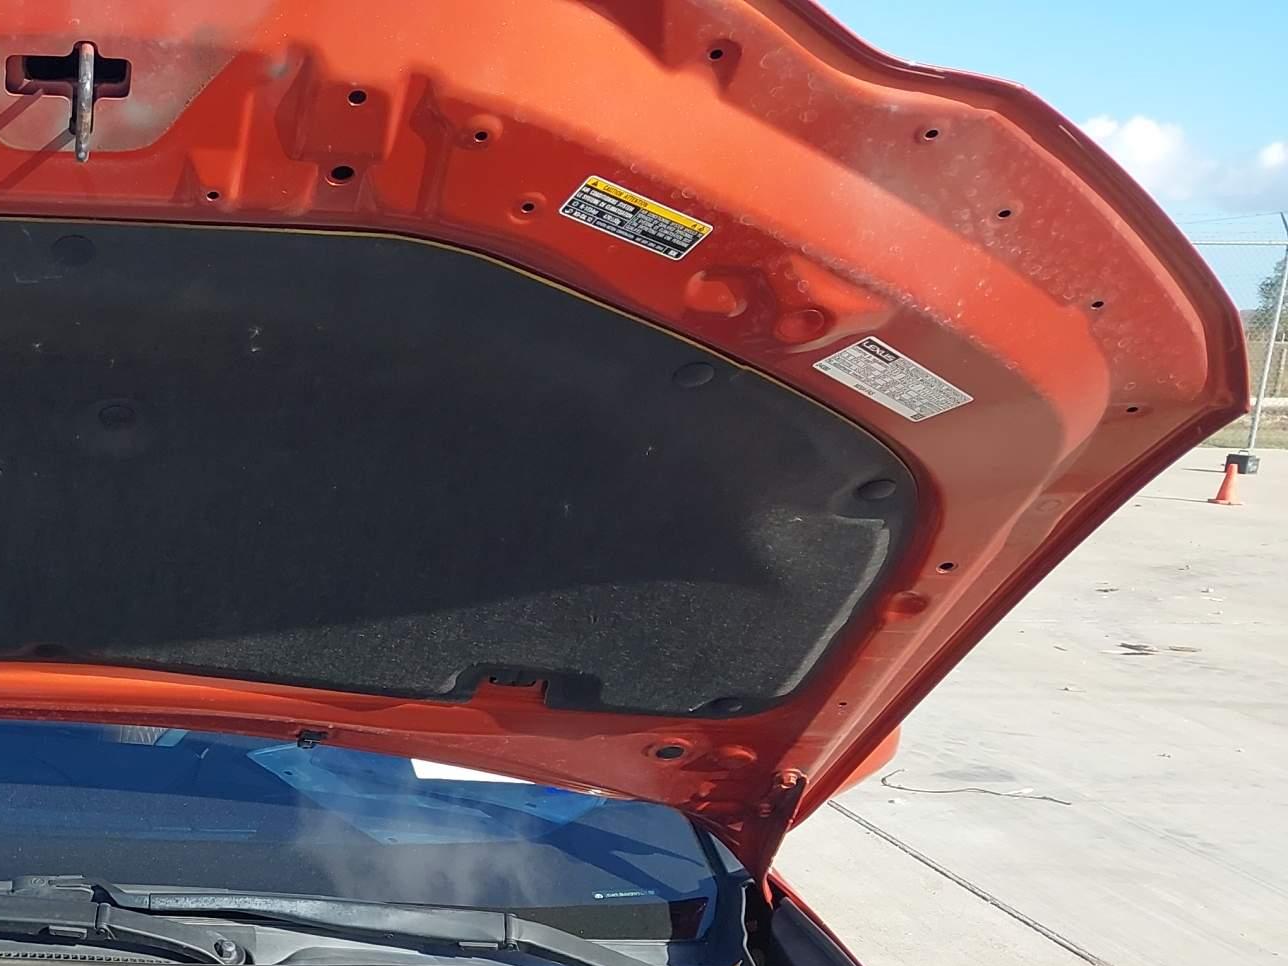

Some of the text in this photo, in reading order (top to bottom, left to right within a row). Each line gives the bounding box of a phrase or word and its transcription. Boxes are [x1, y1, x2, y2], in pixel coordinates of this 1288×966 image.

[603, 185, 649, 207] CAUTION ATTENTION
[862, 341, 897, 362] LEXUS
